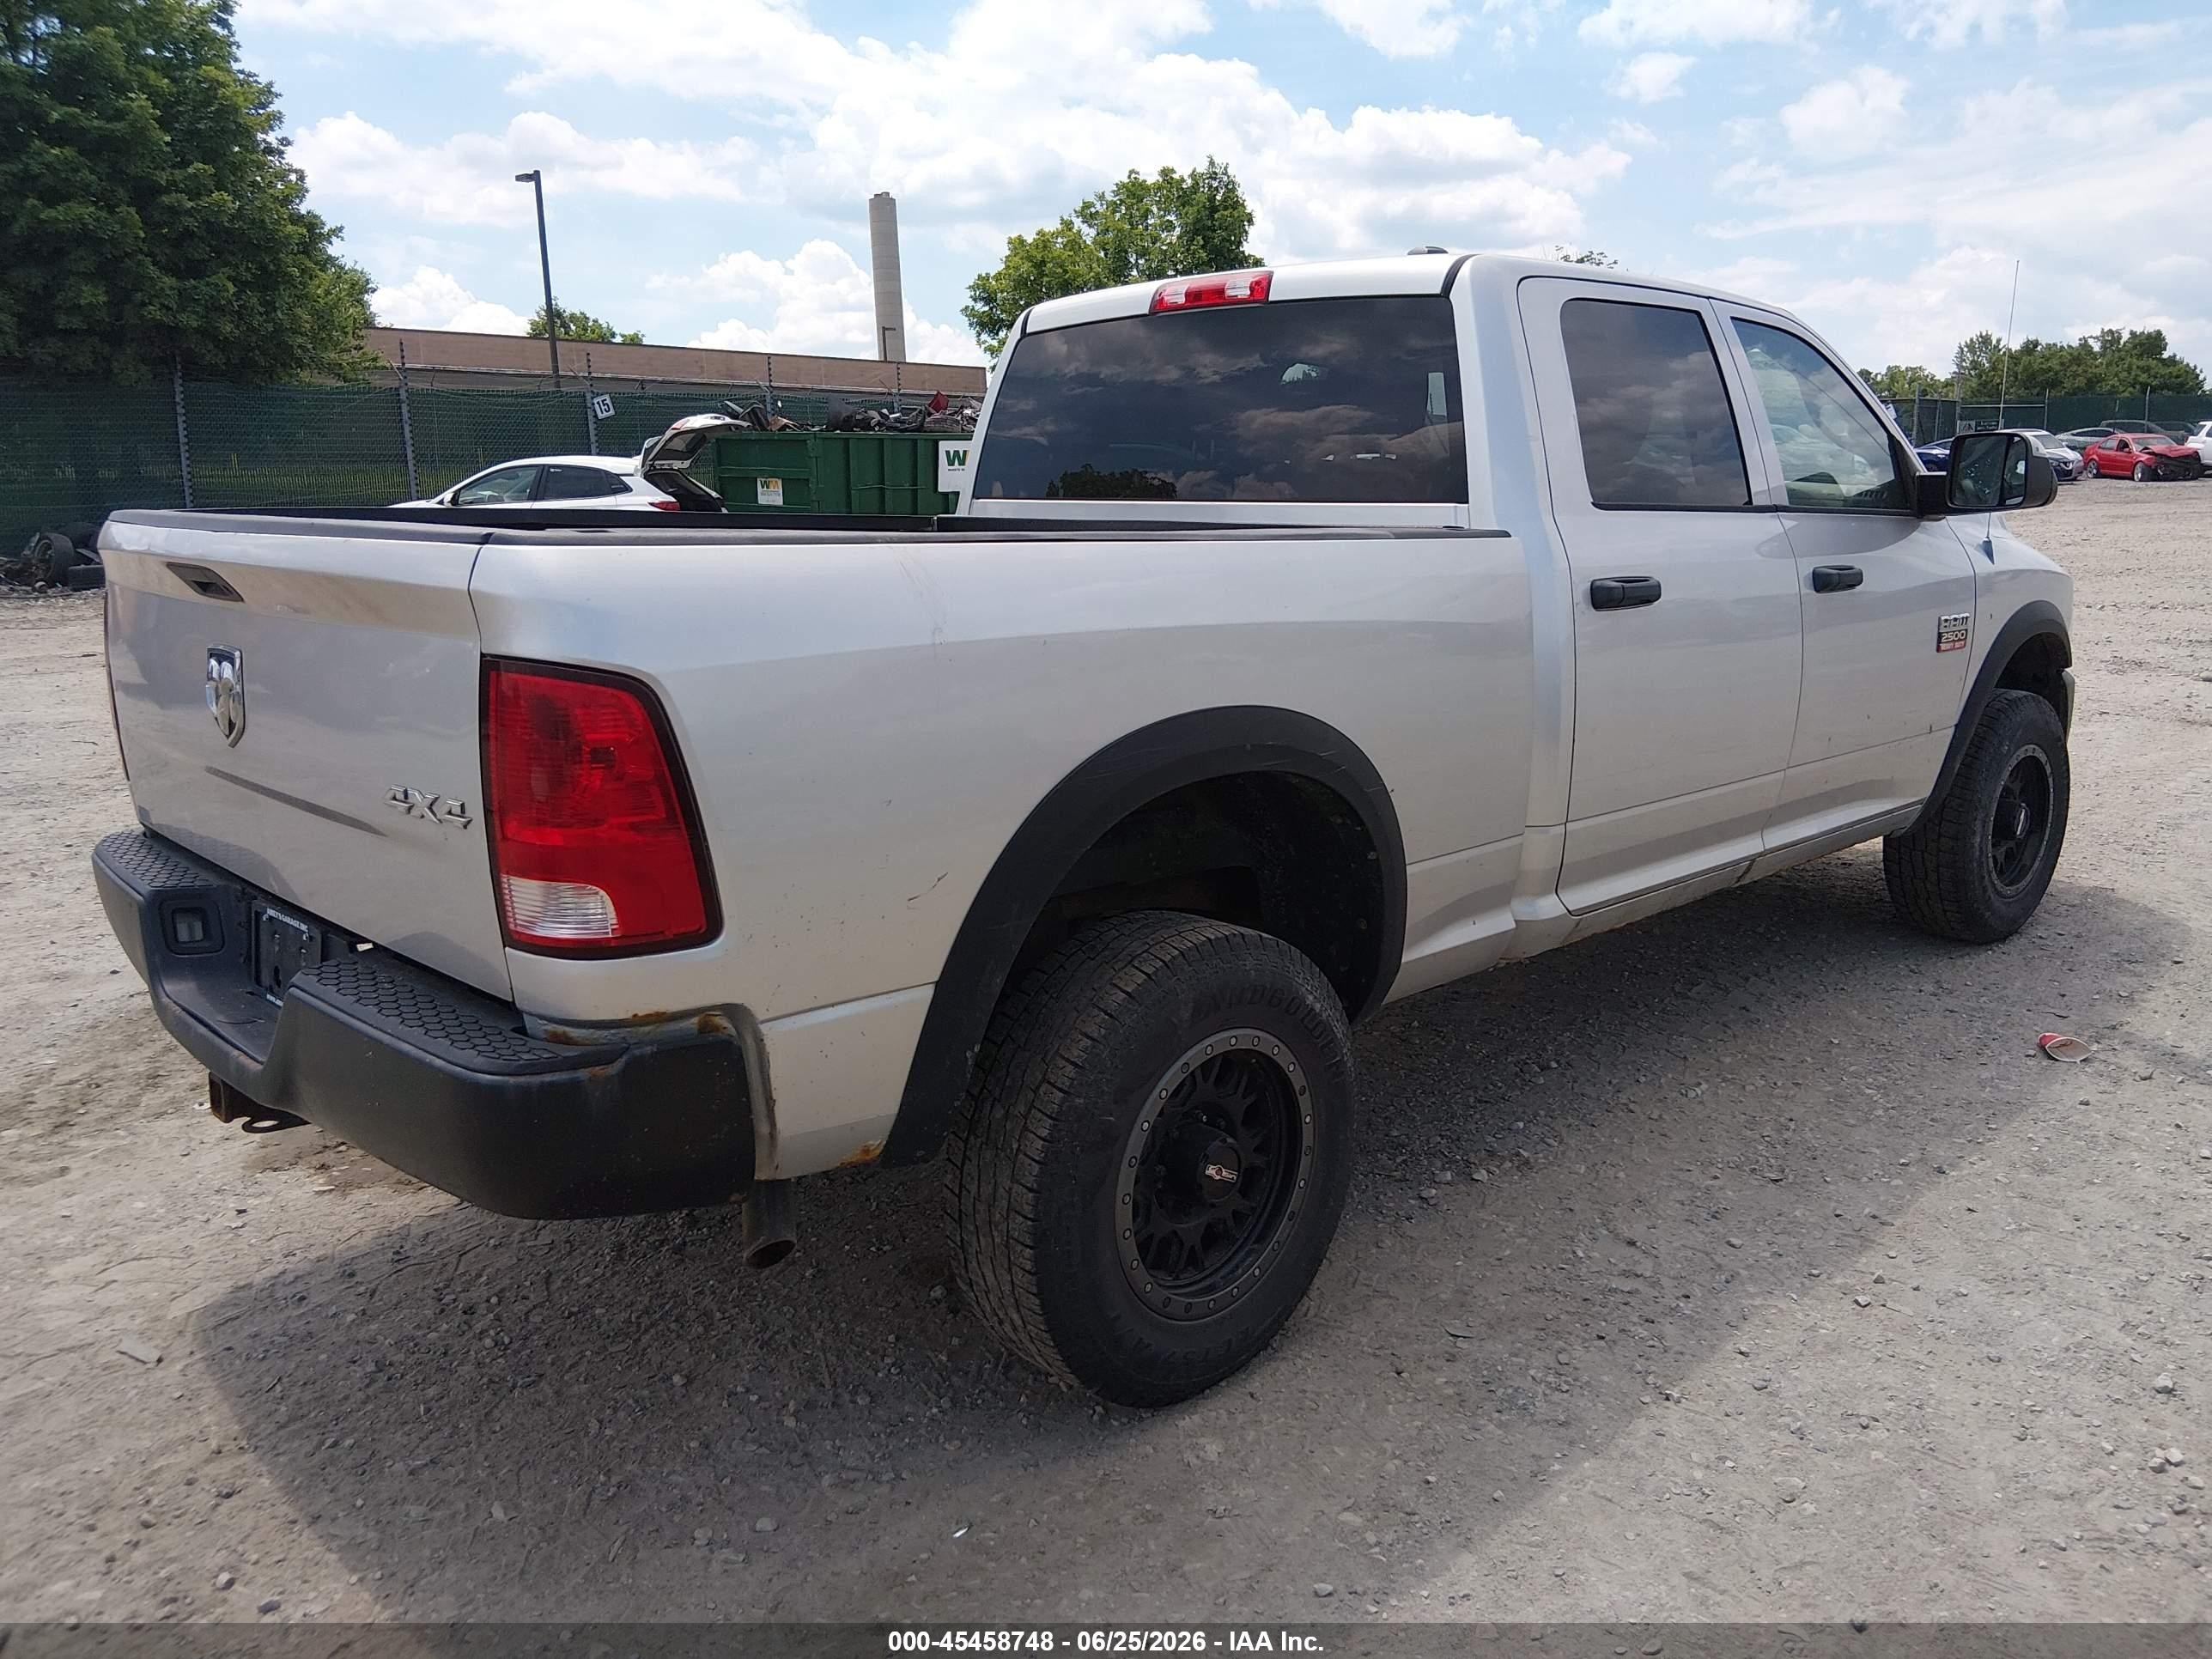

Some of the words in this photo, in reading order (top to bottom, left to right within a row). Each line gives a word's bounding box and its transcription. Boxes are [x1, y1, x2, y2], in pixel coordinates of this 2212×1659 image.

[596, 398, 611, 415] 15
[760, 479, 780, 489] WM
[1940, 612, 1970, 629] RAM
[1941, 630, 1966, 642] 2500
